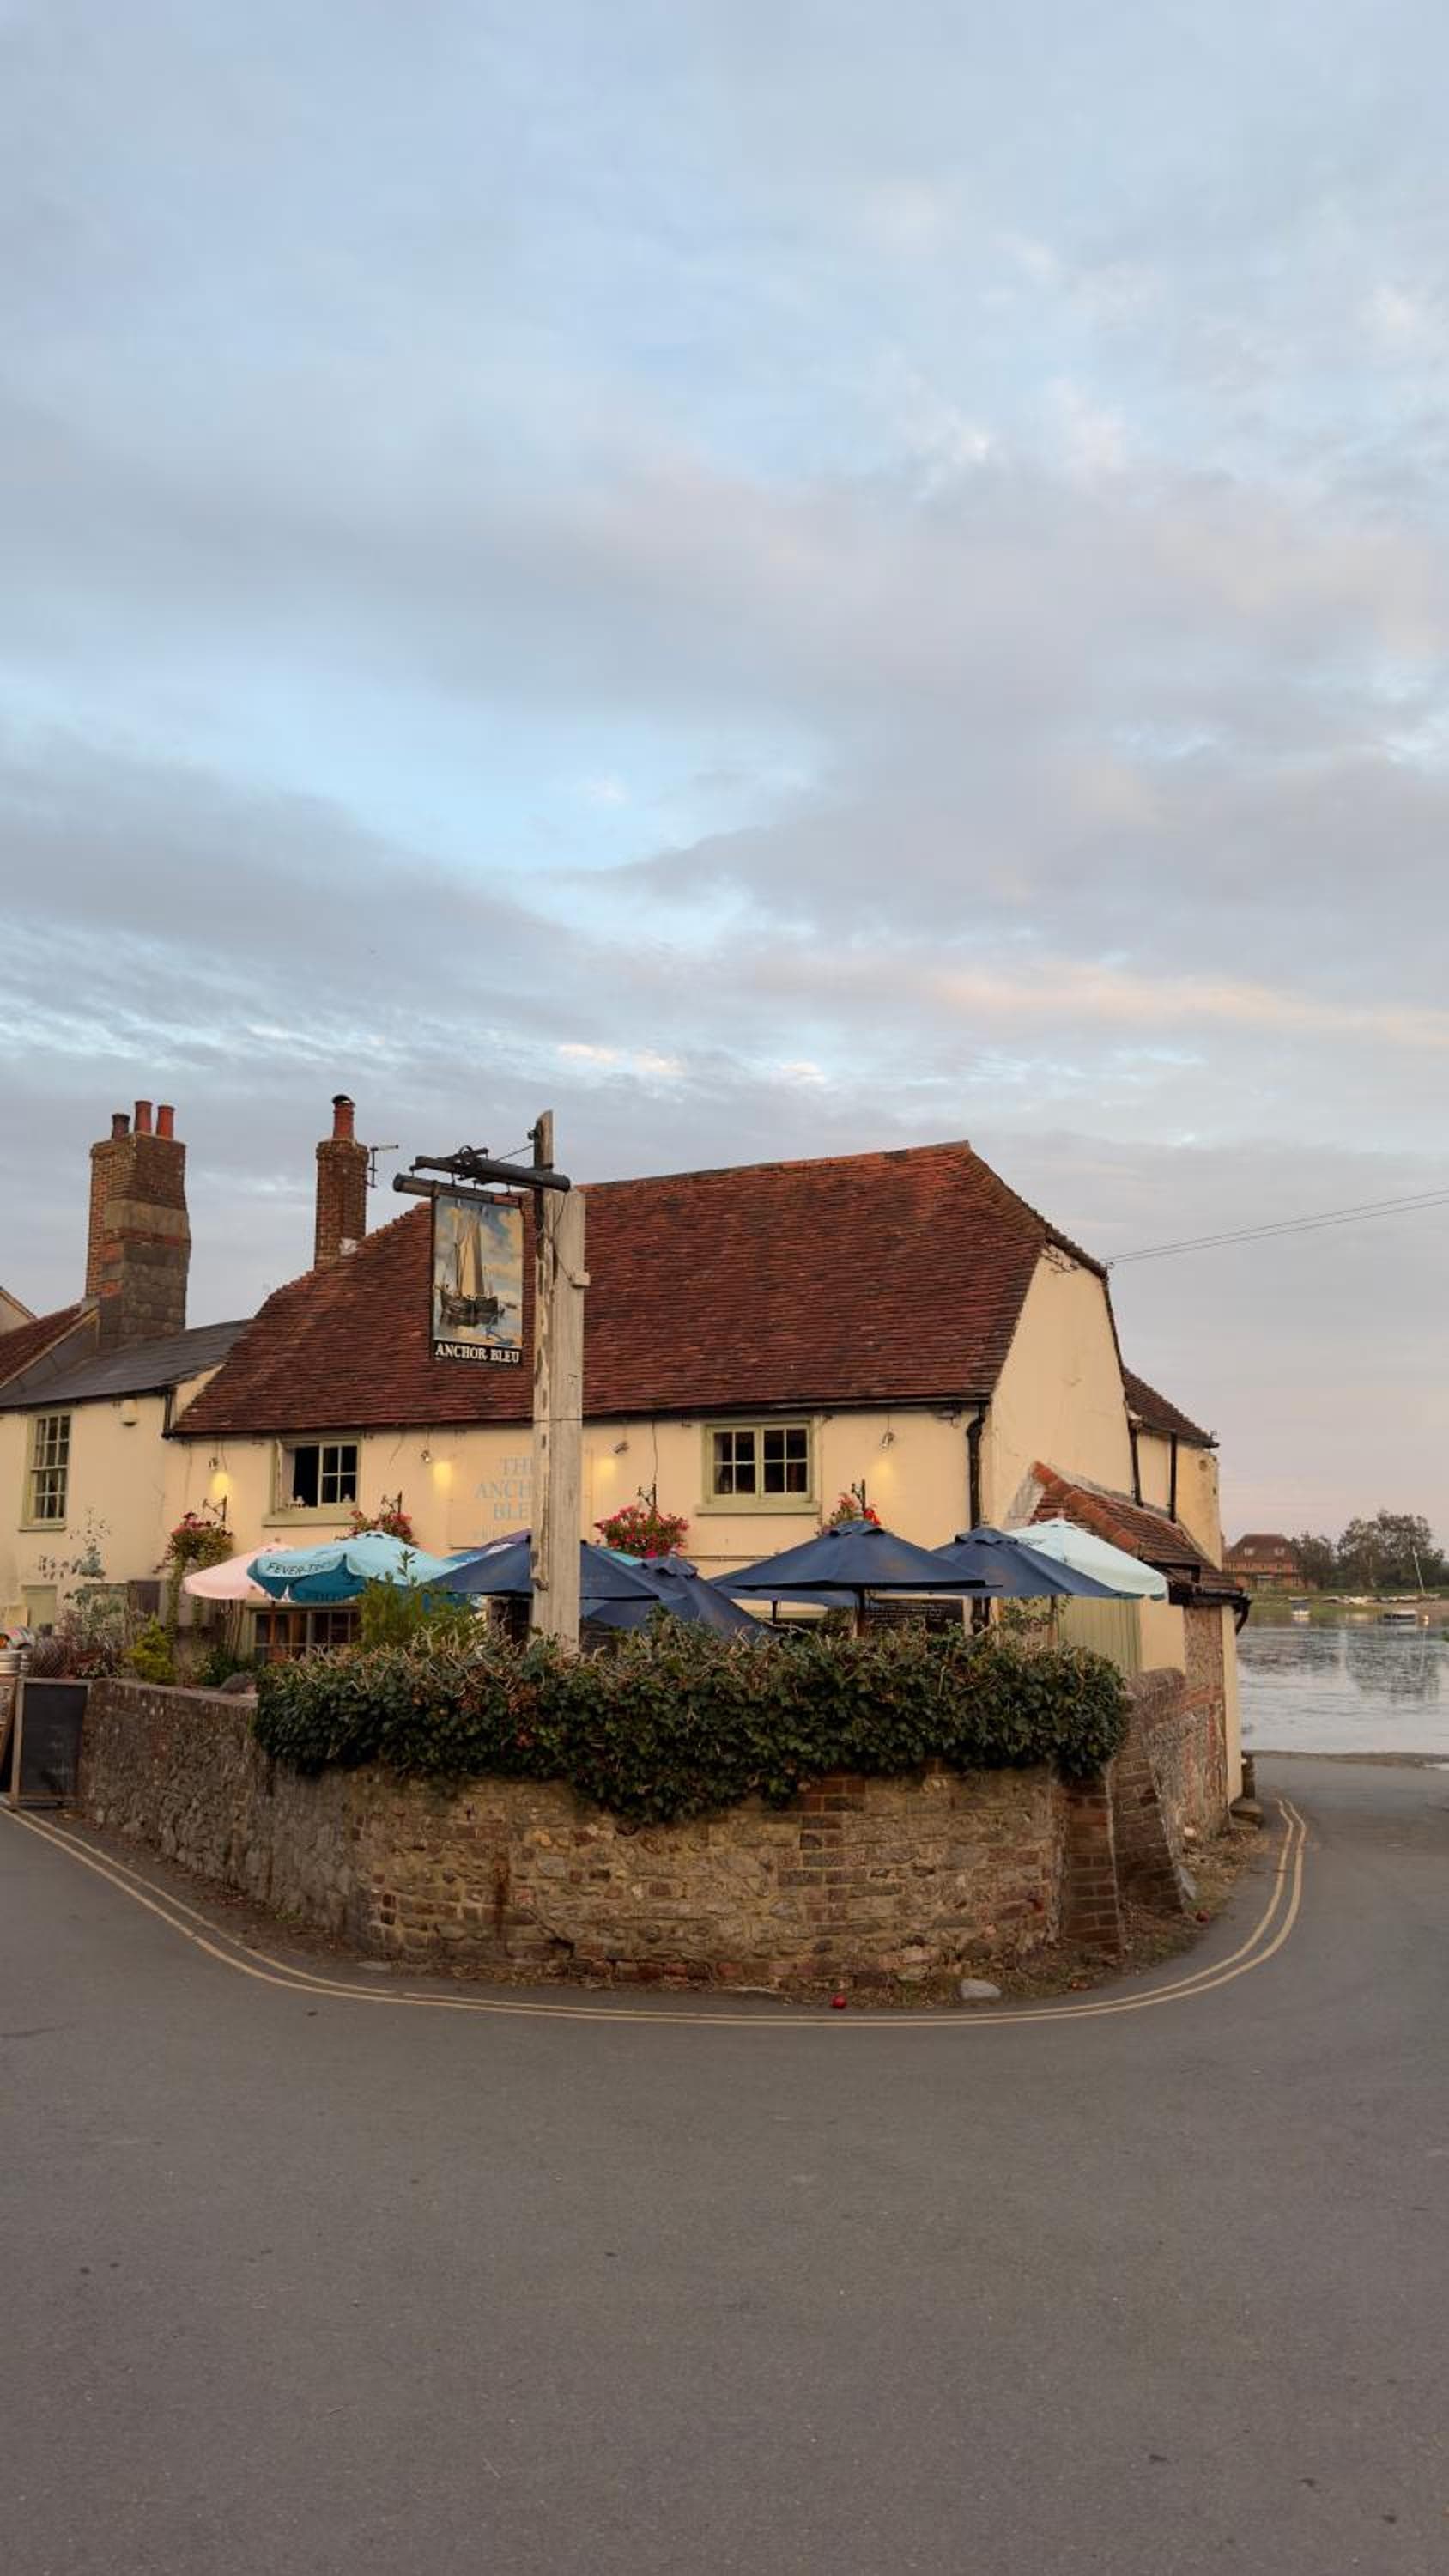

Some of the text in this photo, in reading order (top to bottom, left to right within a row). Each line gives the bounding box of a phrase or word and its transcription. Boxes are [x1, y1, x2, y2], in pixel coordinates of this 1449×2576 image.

[435, 1342, 520, 1363] ANCHOR BLEU
[500, 1456, 532, 1475] TH
[475, 1481, 532, 1498] ANCH
[494, 1504, 530, 1519] BLE
